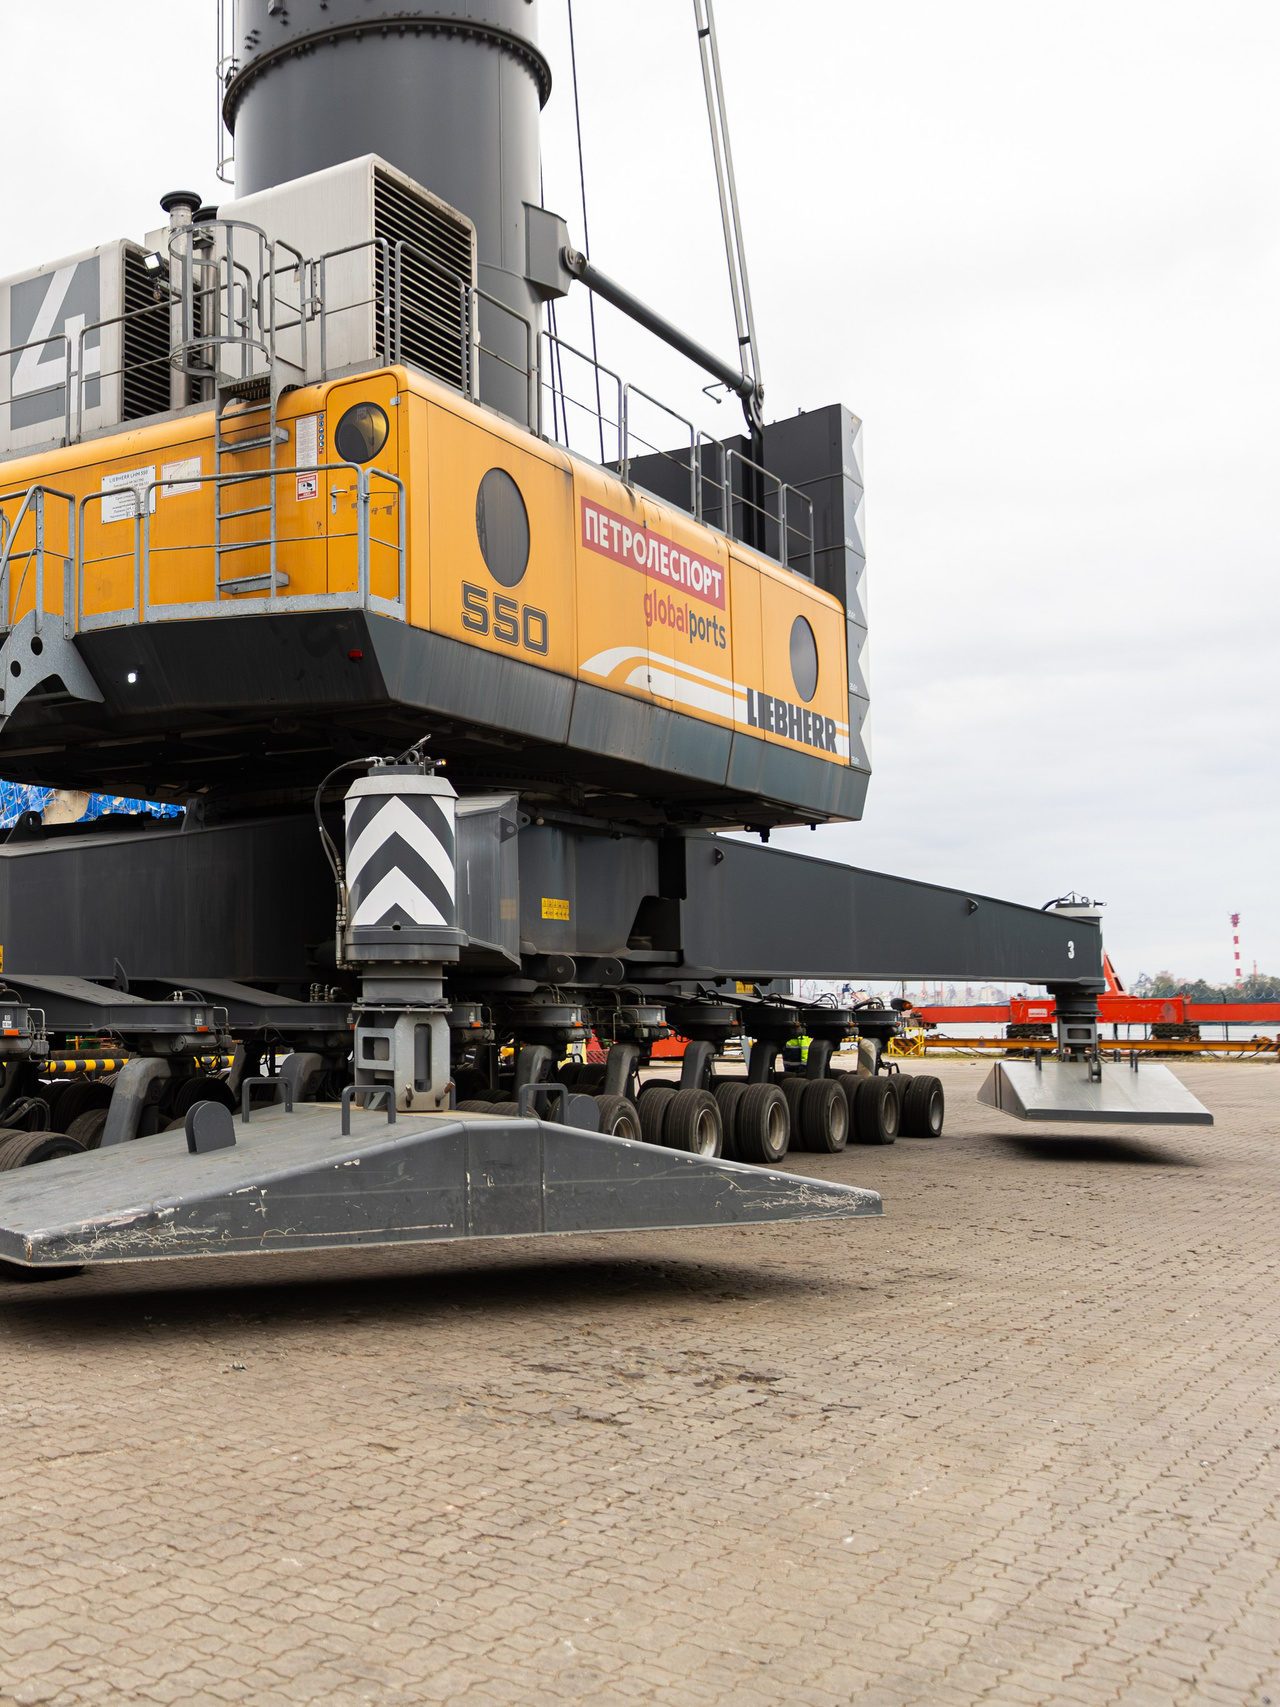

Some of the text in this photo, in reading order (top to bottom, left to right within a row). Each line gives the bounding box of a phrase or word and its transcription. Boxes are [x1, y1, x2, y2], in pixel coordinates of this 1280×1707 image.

[12, 262, 101, 415] 4
[109, 474, 130, 483] LIEBHERR
[585, 507, 722, 599] ПЕТРОЛЕСПОРТ
[461, 580, 549, 656] 550
[746, 687, 838, 755] LIEBHERR
[1067, 940, 1075, 959] 3
